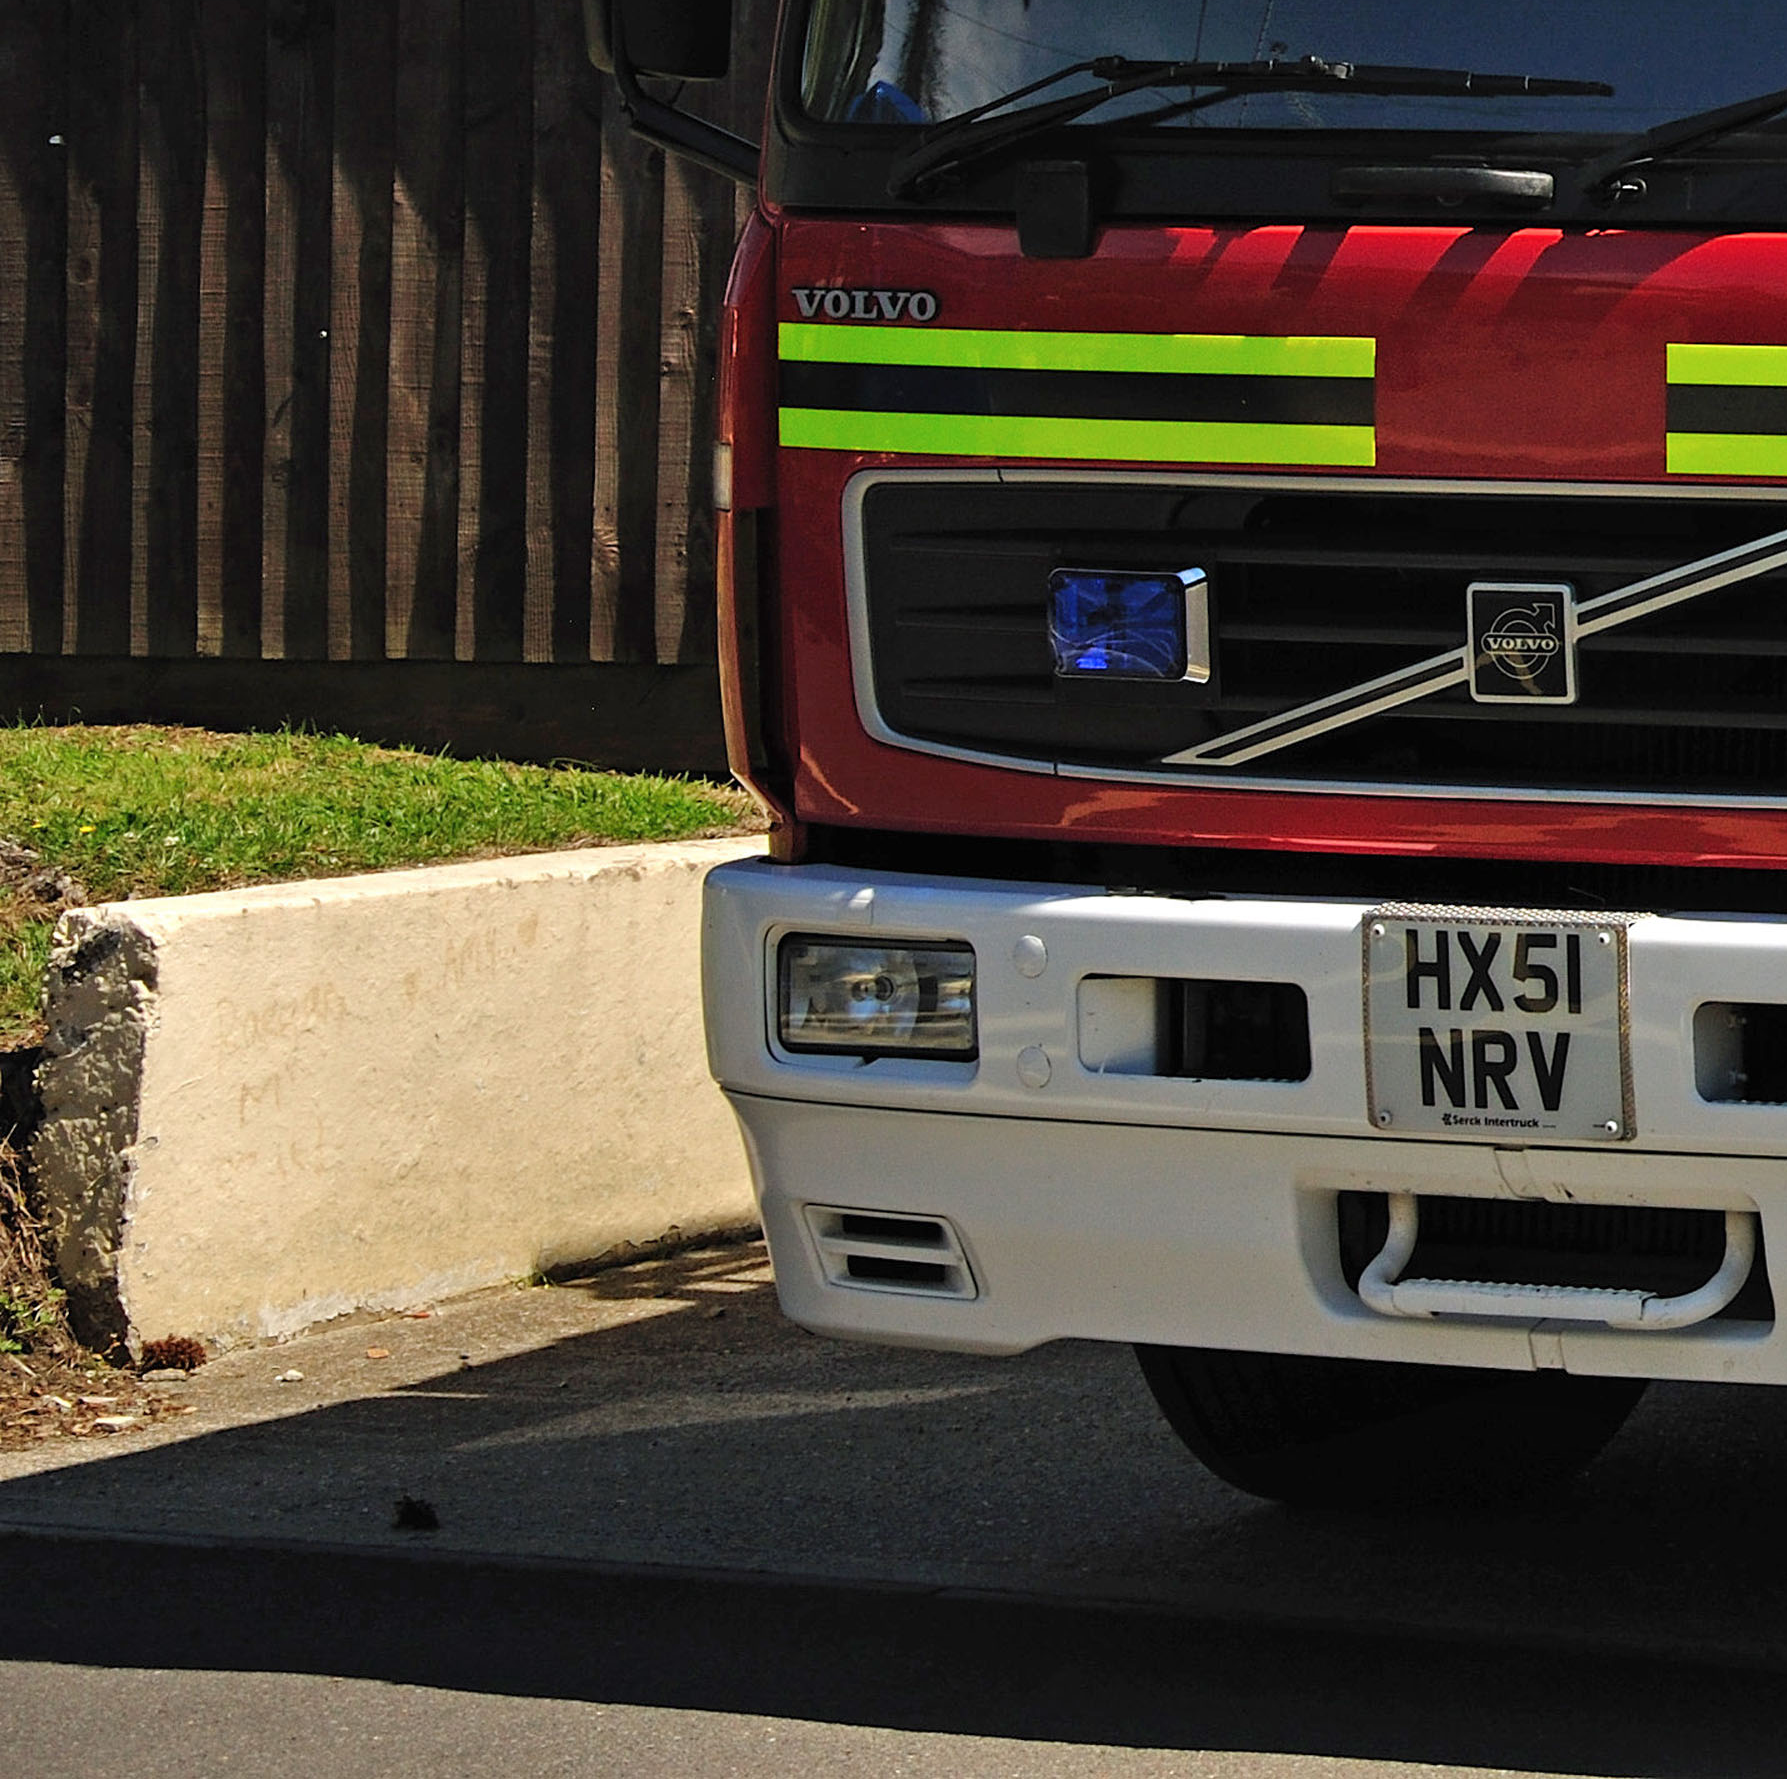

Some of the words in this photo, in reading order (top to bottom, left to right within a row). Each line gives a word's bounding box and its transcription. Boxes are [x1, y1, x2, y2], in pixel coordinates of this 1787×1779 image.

[792, 289, 937, 321] VOLVO
[1486, 637, 1555, 650] VOLVO
[1405, 929, 1582, 1015] HX51
[1419, 1026, 1571, 1112] NRV
[1453, 1114, 1481, 1126] Serck
[1484, 1116, 1540, 1128] Intertruck
